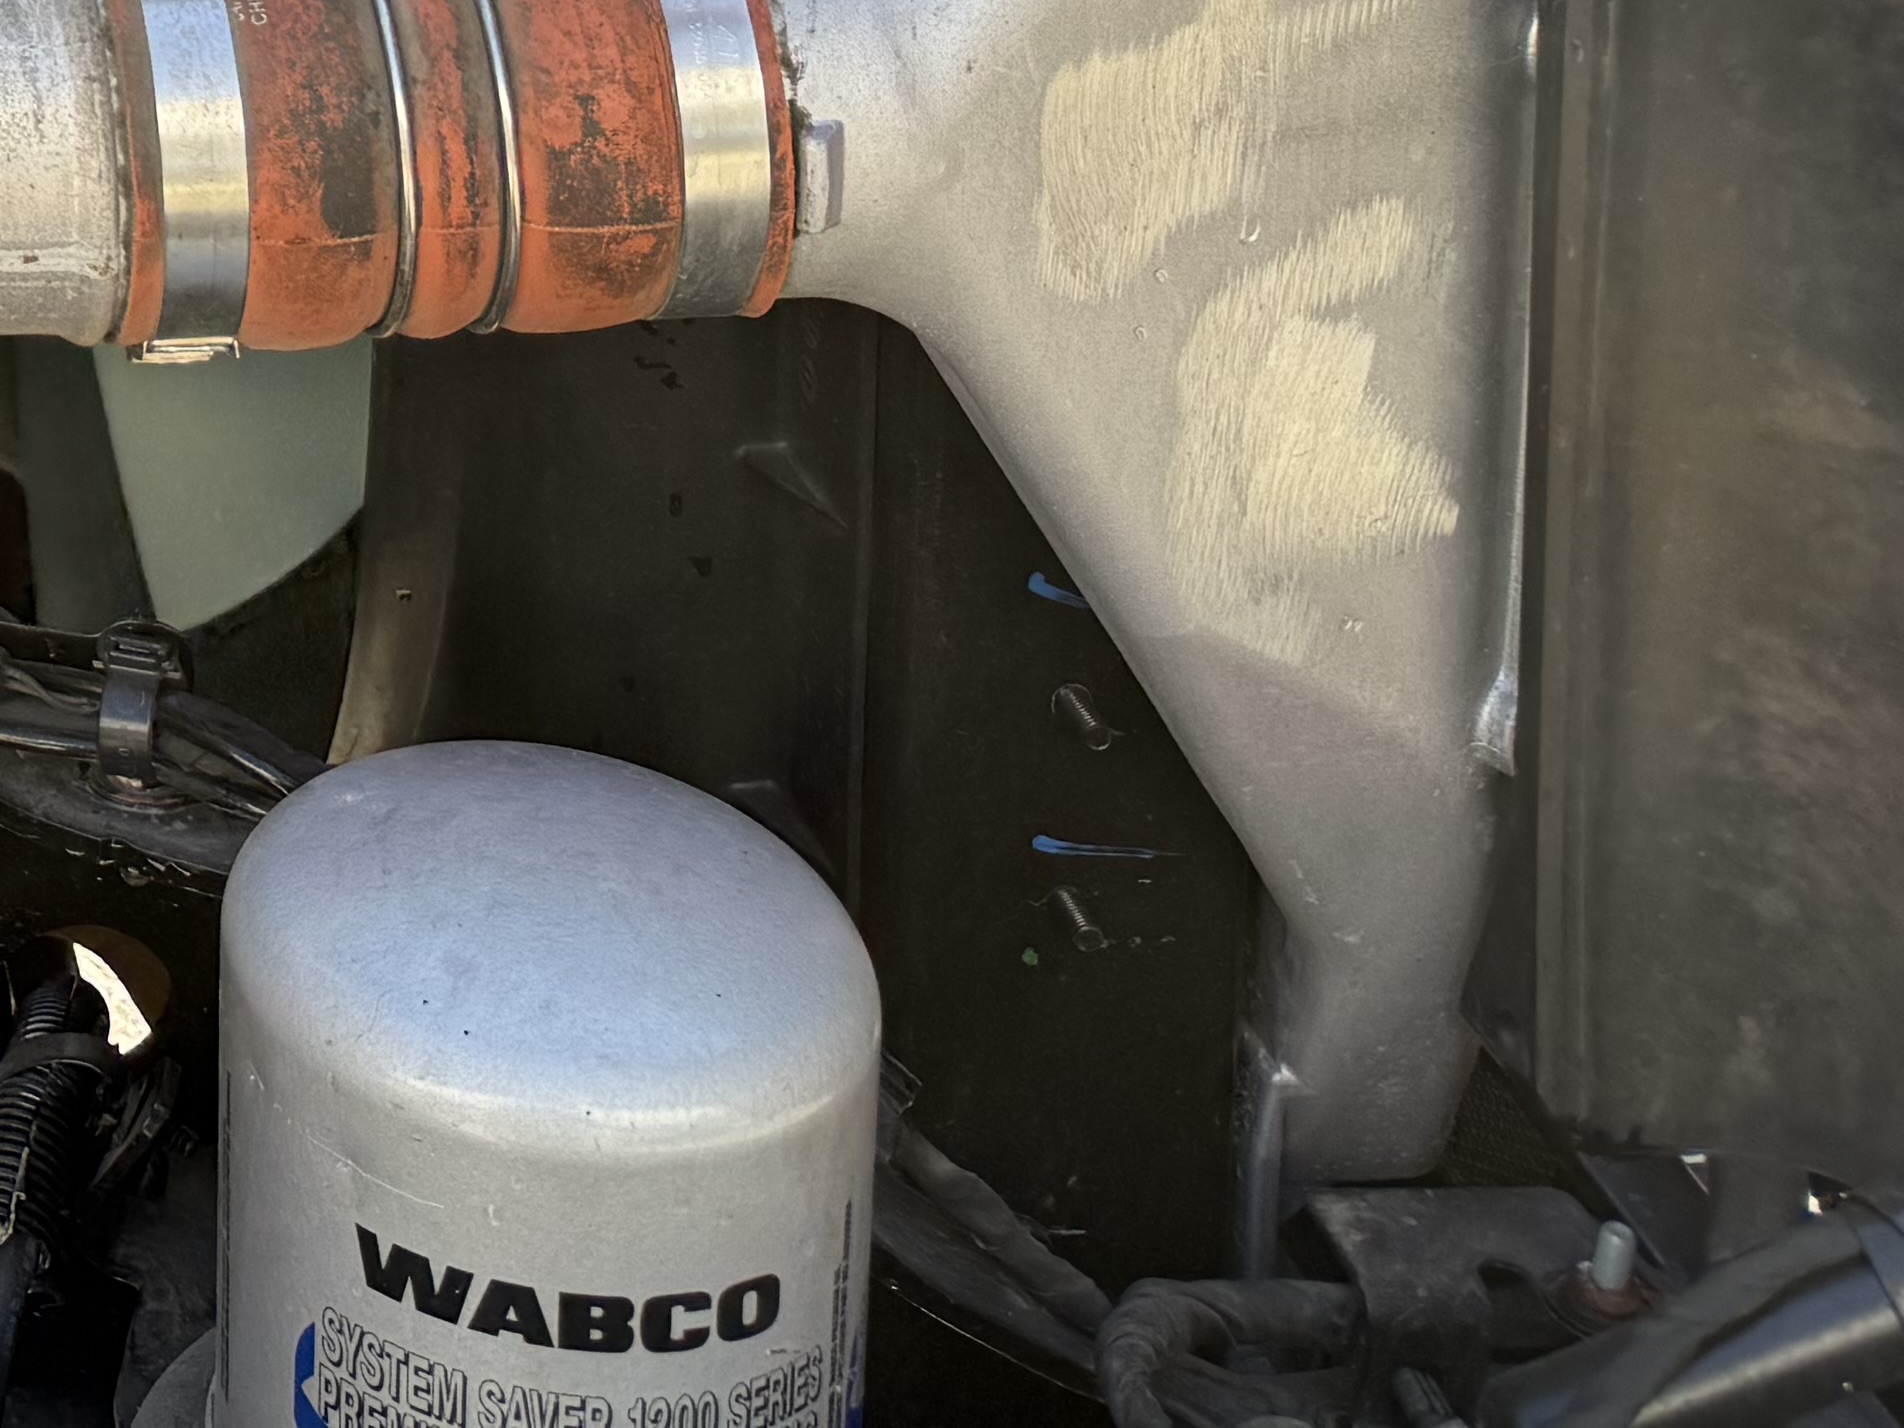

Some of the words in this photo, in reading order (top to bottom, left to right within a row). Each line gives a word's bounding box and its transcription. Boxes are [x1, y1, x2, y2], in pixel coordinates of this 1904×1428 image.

[354, 1222, 781, 1355] WABCO
[320, 1305, 468, 1423] SYSTEM
[477, 1378, 613, 1428] SAVER
[726, 1344, 824, 1428] SERIES
